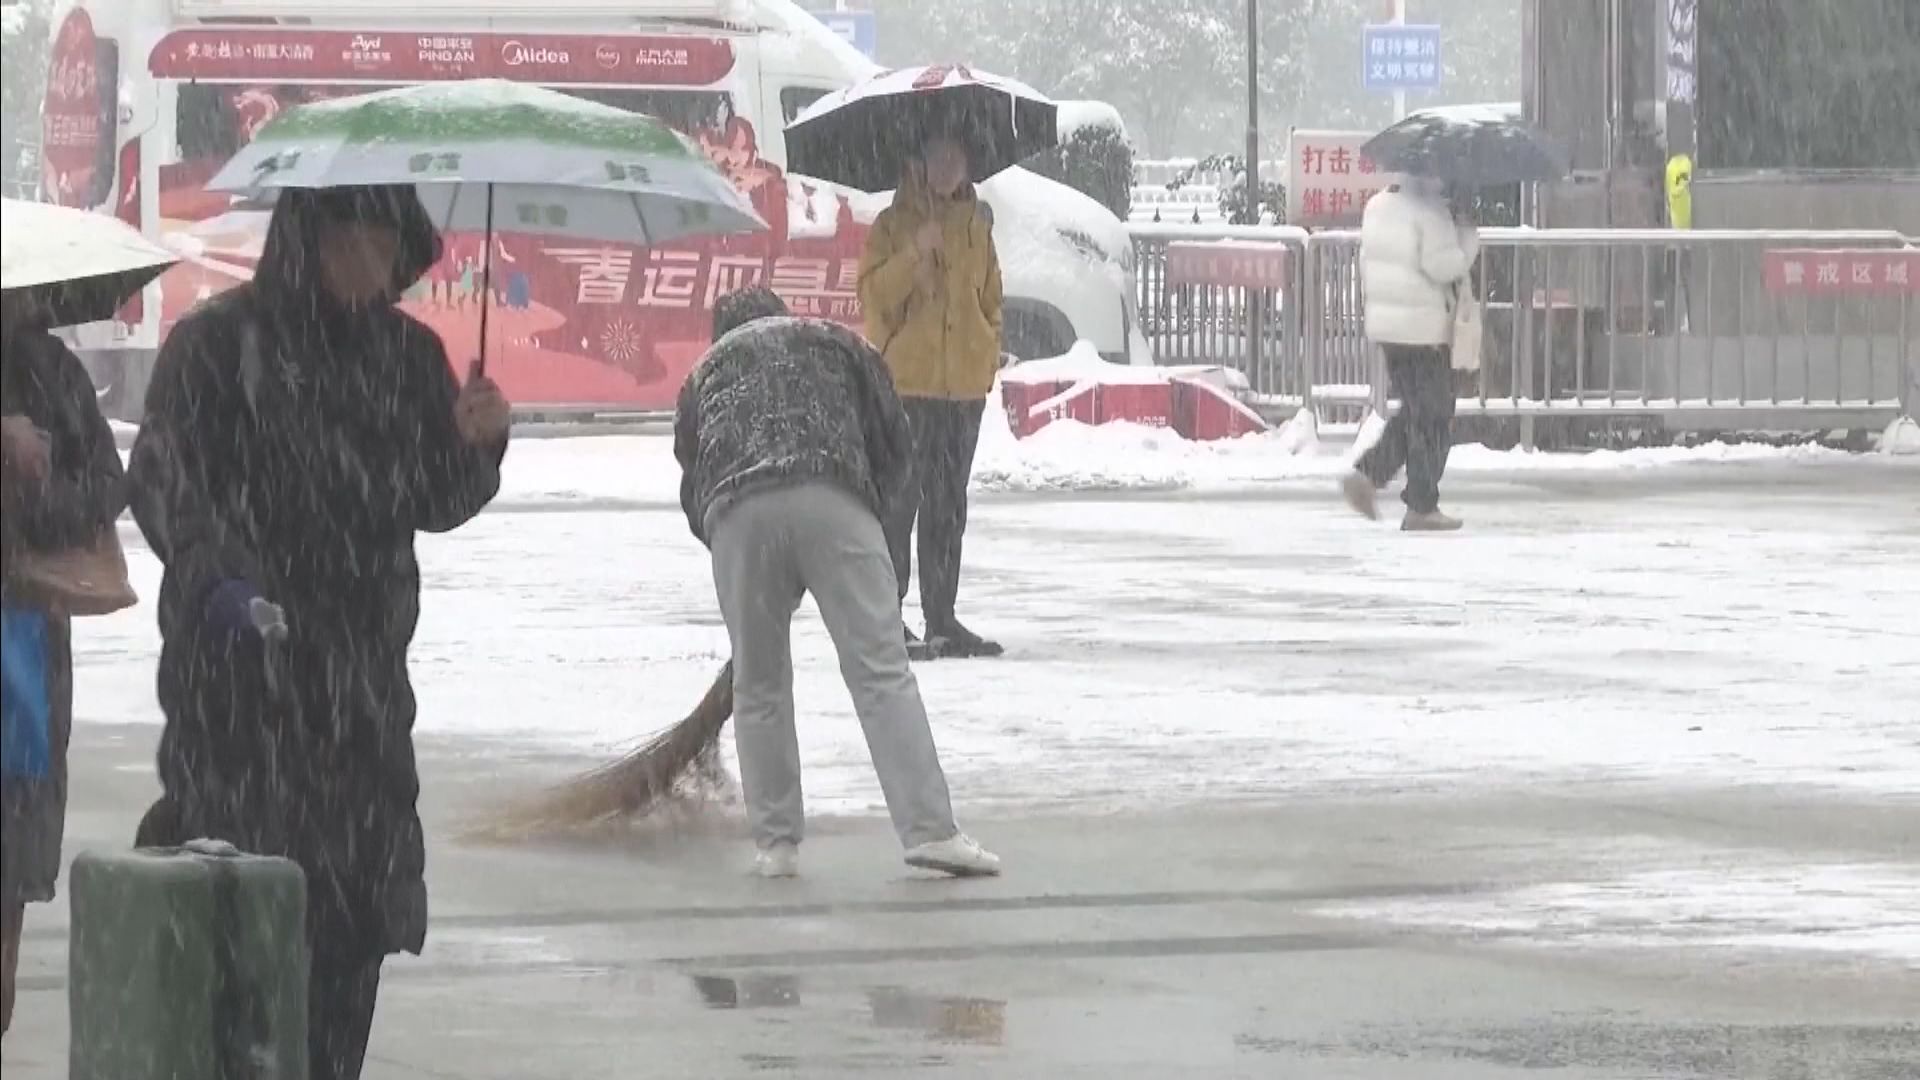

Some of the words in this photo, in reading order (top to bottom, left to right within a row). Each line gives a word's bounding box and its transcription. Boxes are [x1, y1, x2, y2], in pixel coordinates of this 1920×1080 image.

[513, 47, 570, 63] Midea
[1783, 260, 1908, 284] 警戒区域
